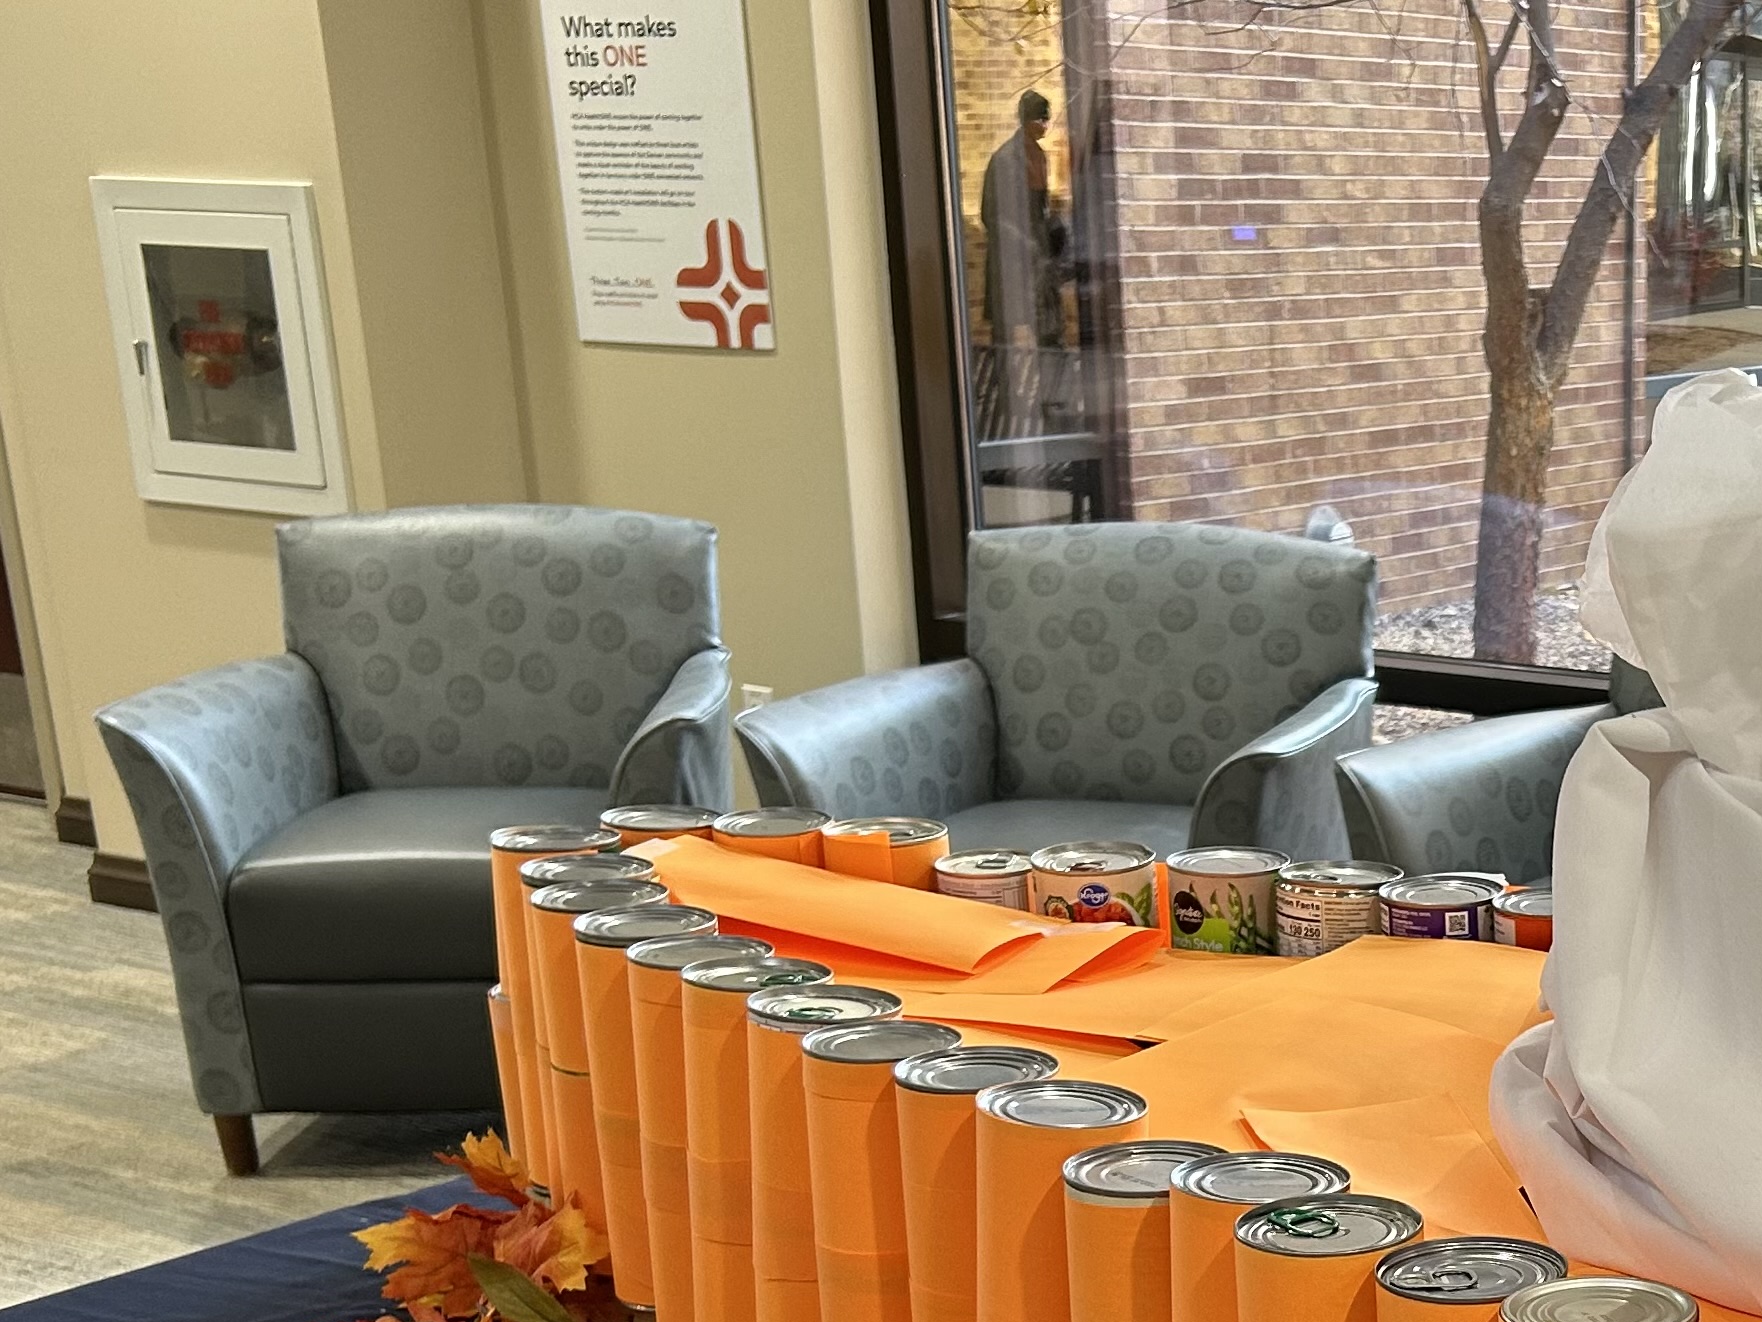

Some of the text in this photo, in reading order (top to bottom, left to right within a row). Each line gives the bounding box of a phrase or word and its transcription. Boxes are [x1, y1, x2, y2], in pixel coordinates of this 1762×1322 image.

[560, 14, 678, 38] What makes
[564, 44, 648, 67] this ONE
[568, 73, 637, 102] special?
[1295, 900, 1321, 911] Facts
[1303, 926, 1321, 938] 250
[1193, 937, 1224, 952] Style
